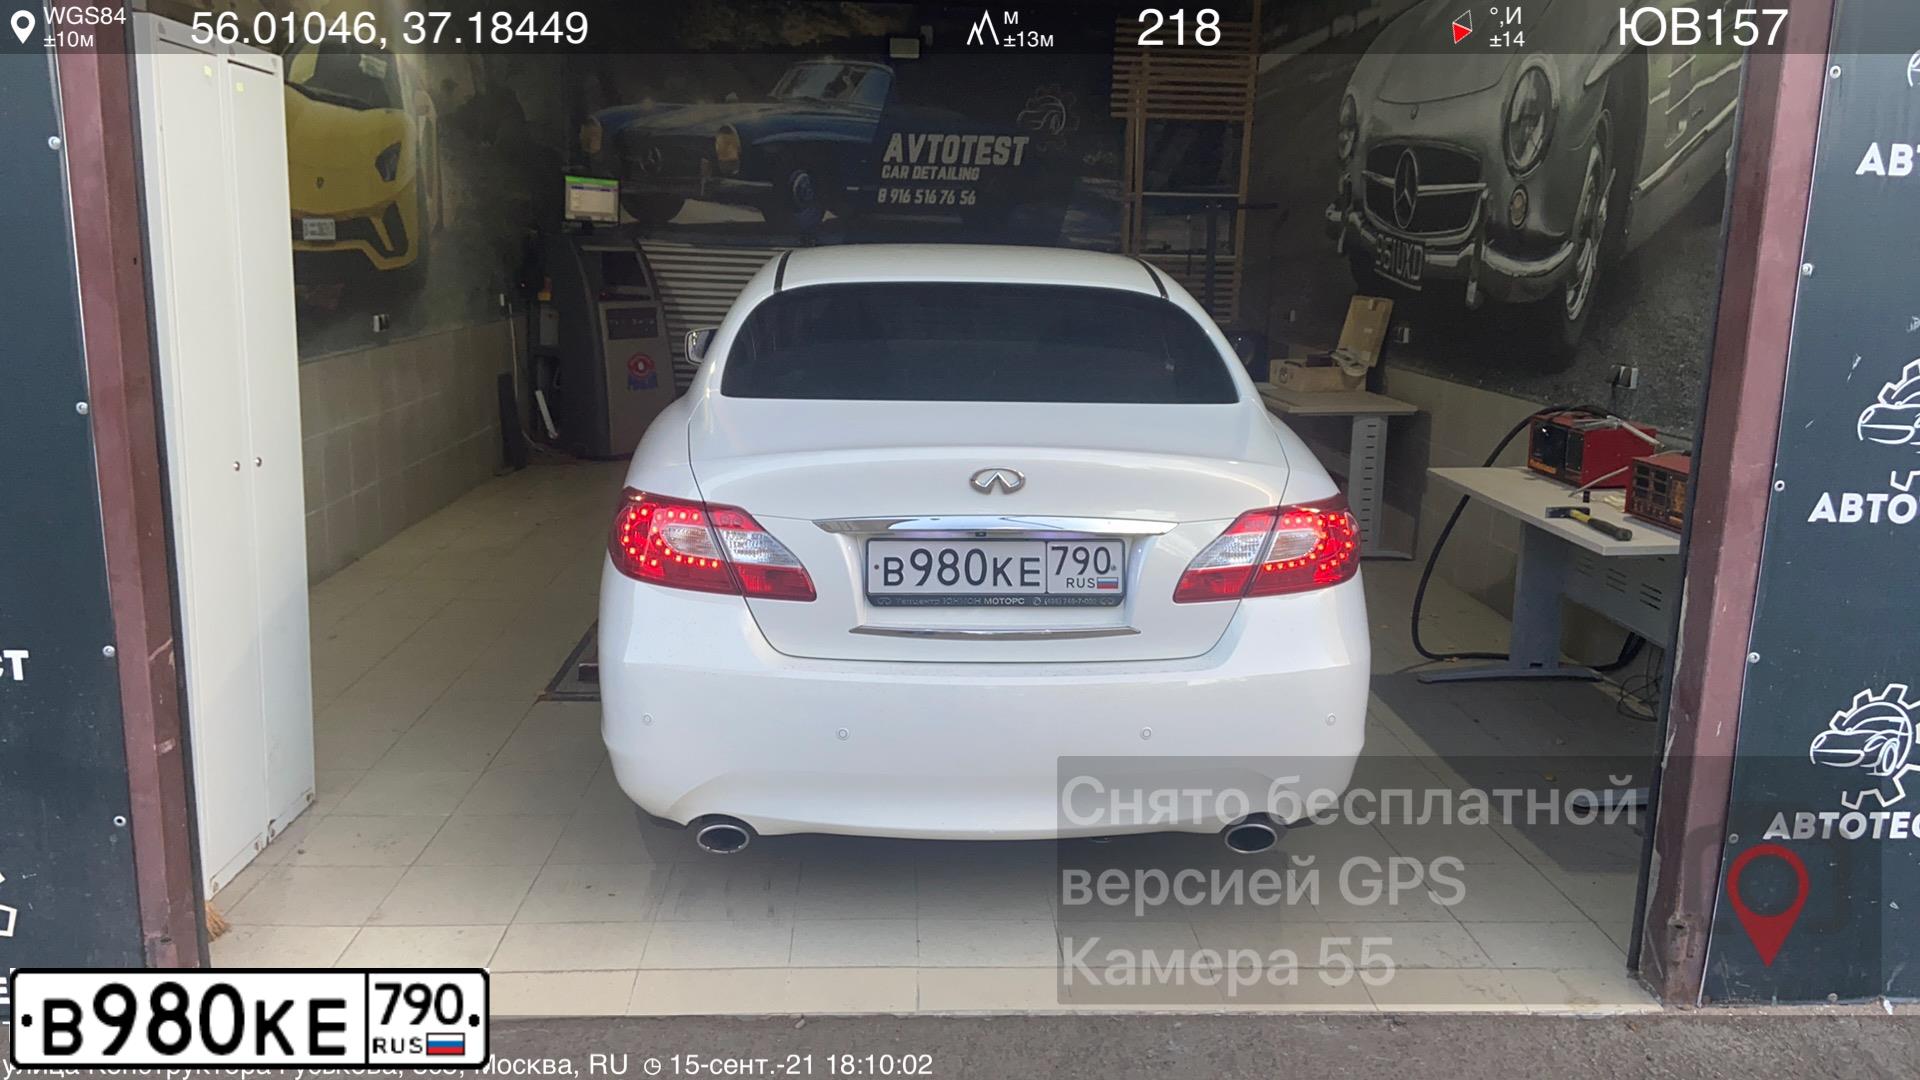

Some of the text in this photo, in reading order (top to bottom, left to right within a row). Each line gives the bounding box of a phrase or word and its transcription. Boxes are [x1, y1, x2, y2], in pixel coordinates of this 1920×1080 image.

[882, 132, 1030, 166] AVTOTEST
[1855, 142, 1920, 176] АВ
[881, 164, 980, 181] CAR DETAILING
[877, 188, 977, 206] 8 916 516 76 56
[883, 546, 1112, 587] В980КЕ 790
[1066, 577, 1096, 589] RUS
[984, 597, 1025, 605] МОТОРС
[0, 650, 29, 680] Т
